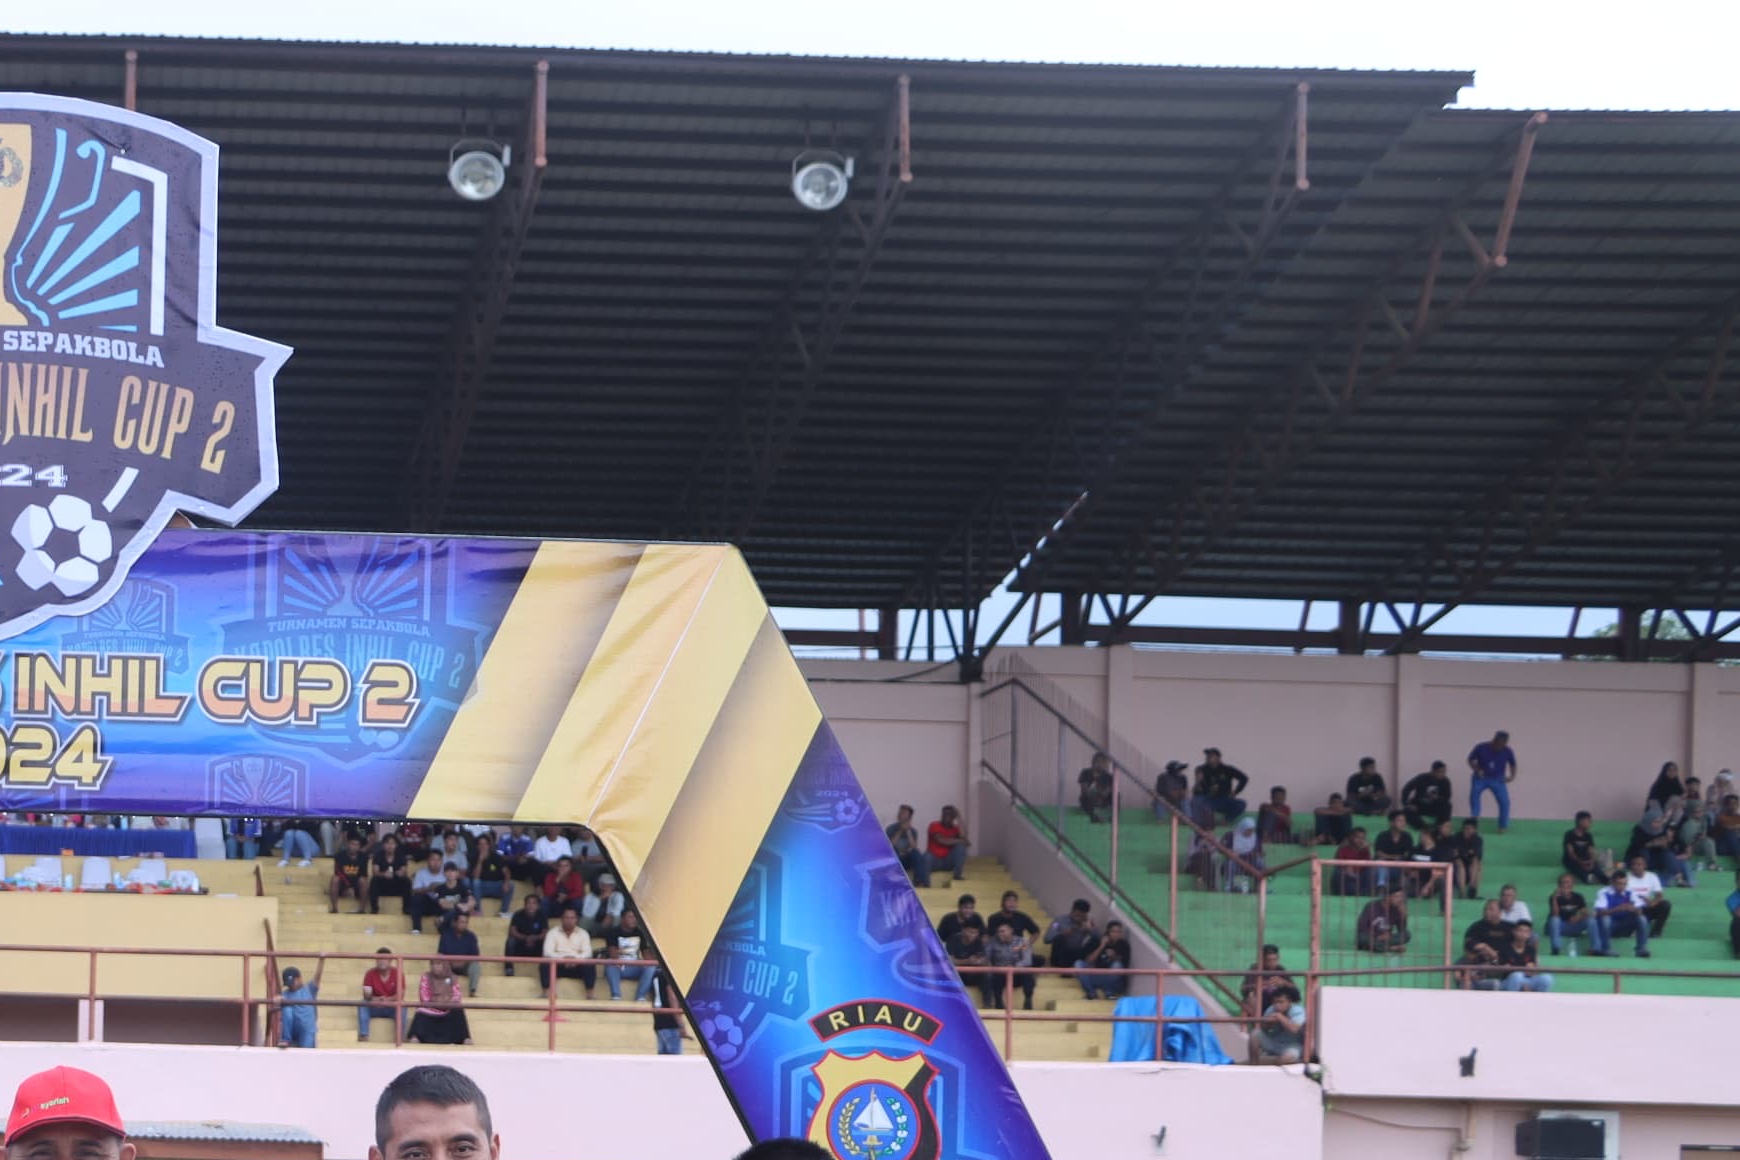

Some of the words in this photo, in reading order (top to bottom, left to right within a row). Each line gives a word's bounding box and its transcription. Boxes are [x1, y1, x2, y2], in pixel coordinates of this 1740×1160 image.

[3, 330, 165, 368] SEPAKBOLA
[112, 375, 195, 460] CUP
[200, 401, 236, 475] 2
[13, 650, 191, 721] INHIL
[197, 654, 351, 725] CUP
[356, 658, 420, 727] 2
[743, 959, 780, 998] CUP
[782, 970, 798, 1006] 2
[828, 1005, 923, 1032] RIAU
